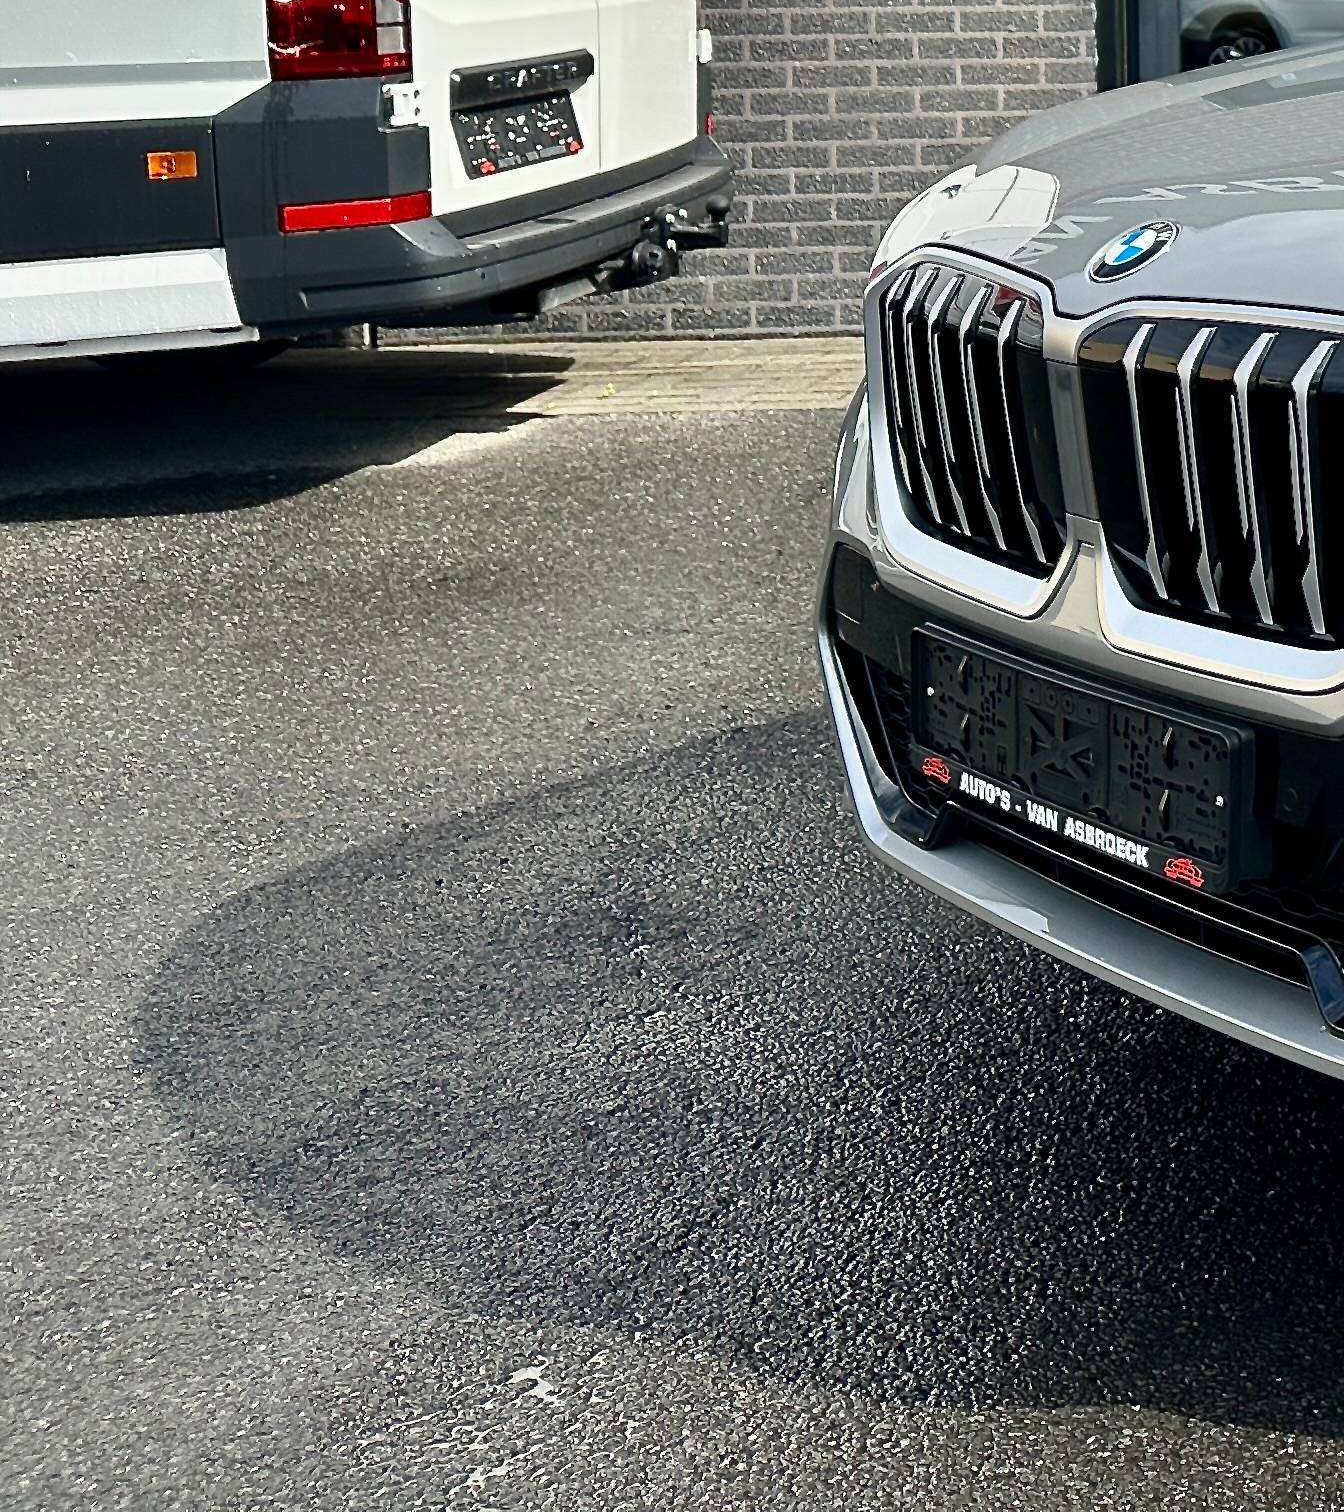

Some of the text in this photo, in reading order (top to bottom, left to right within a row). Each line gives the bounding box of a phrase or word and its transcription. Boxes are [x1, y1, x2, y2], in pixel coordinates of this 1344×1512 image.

[959, 772, 1012, 812] AUTO'S
[1026, 799, 1059, 833] VAN
[1063, 816, 1150, 869] ASBROECK
